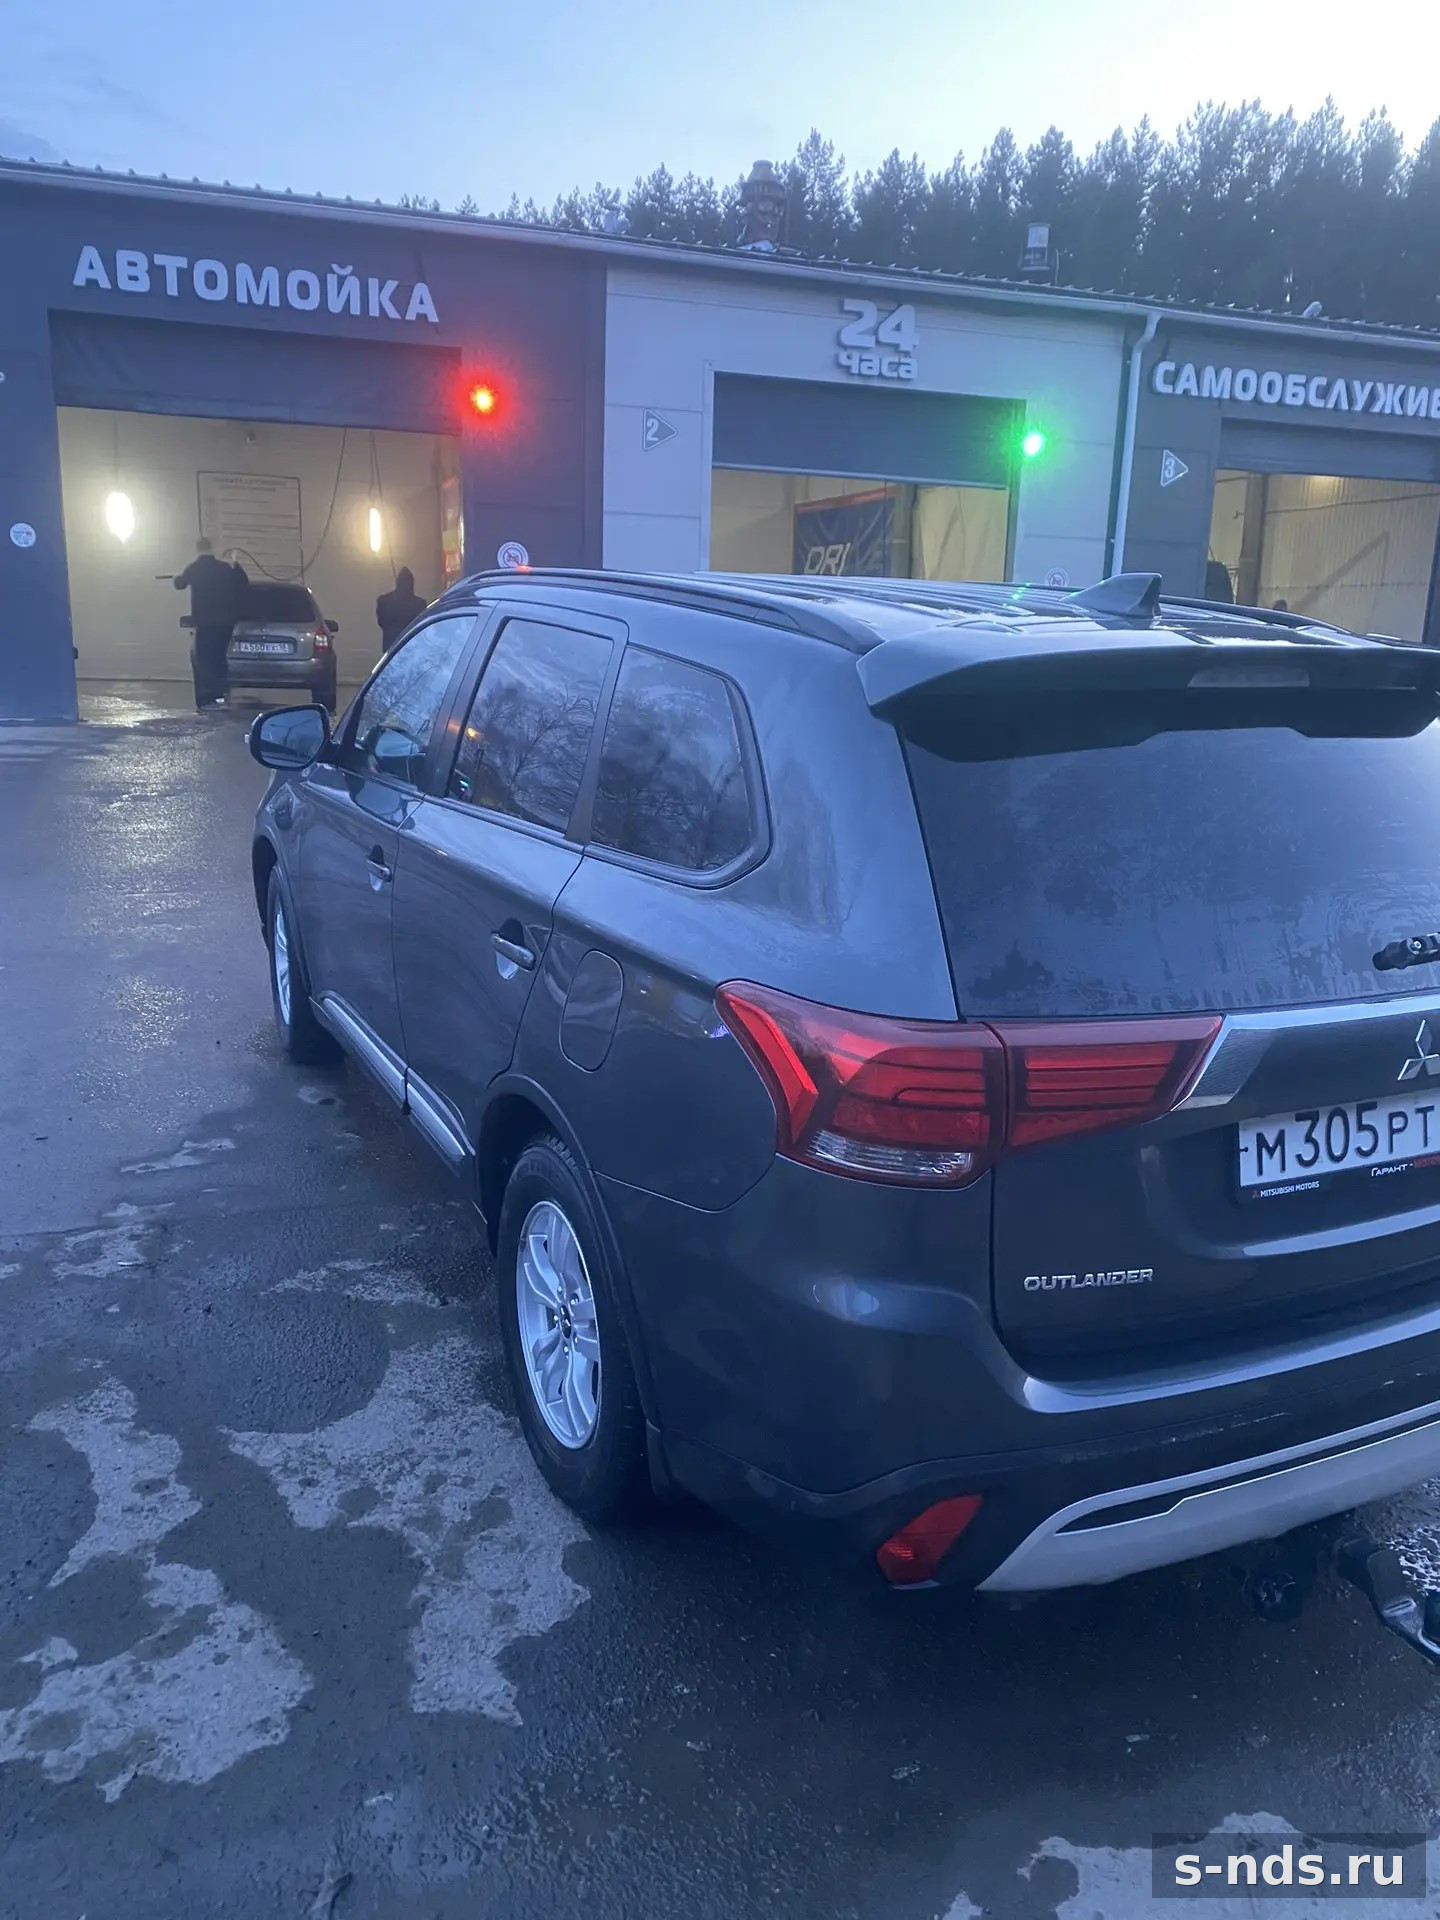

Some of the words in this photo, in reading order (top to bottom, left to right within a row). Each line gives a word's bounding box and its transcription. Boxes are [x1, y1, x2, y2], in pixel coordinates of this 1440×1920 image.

[73, 245, 440, 323] АВТОМОЙКА
[840, 298, 919, 351] 24
[838, 351, 918, 379] часа
[646, 418, 660, 441] 2
[1164, 457, 1176, 478] 3
[1260, 1185, 1295, 1198] MITSUBISHI
[1295, 1180, 1320, 1191] MOTORS
[1023, 1268, 1153, 1291] OUTLANDER
